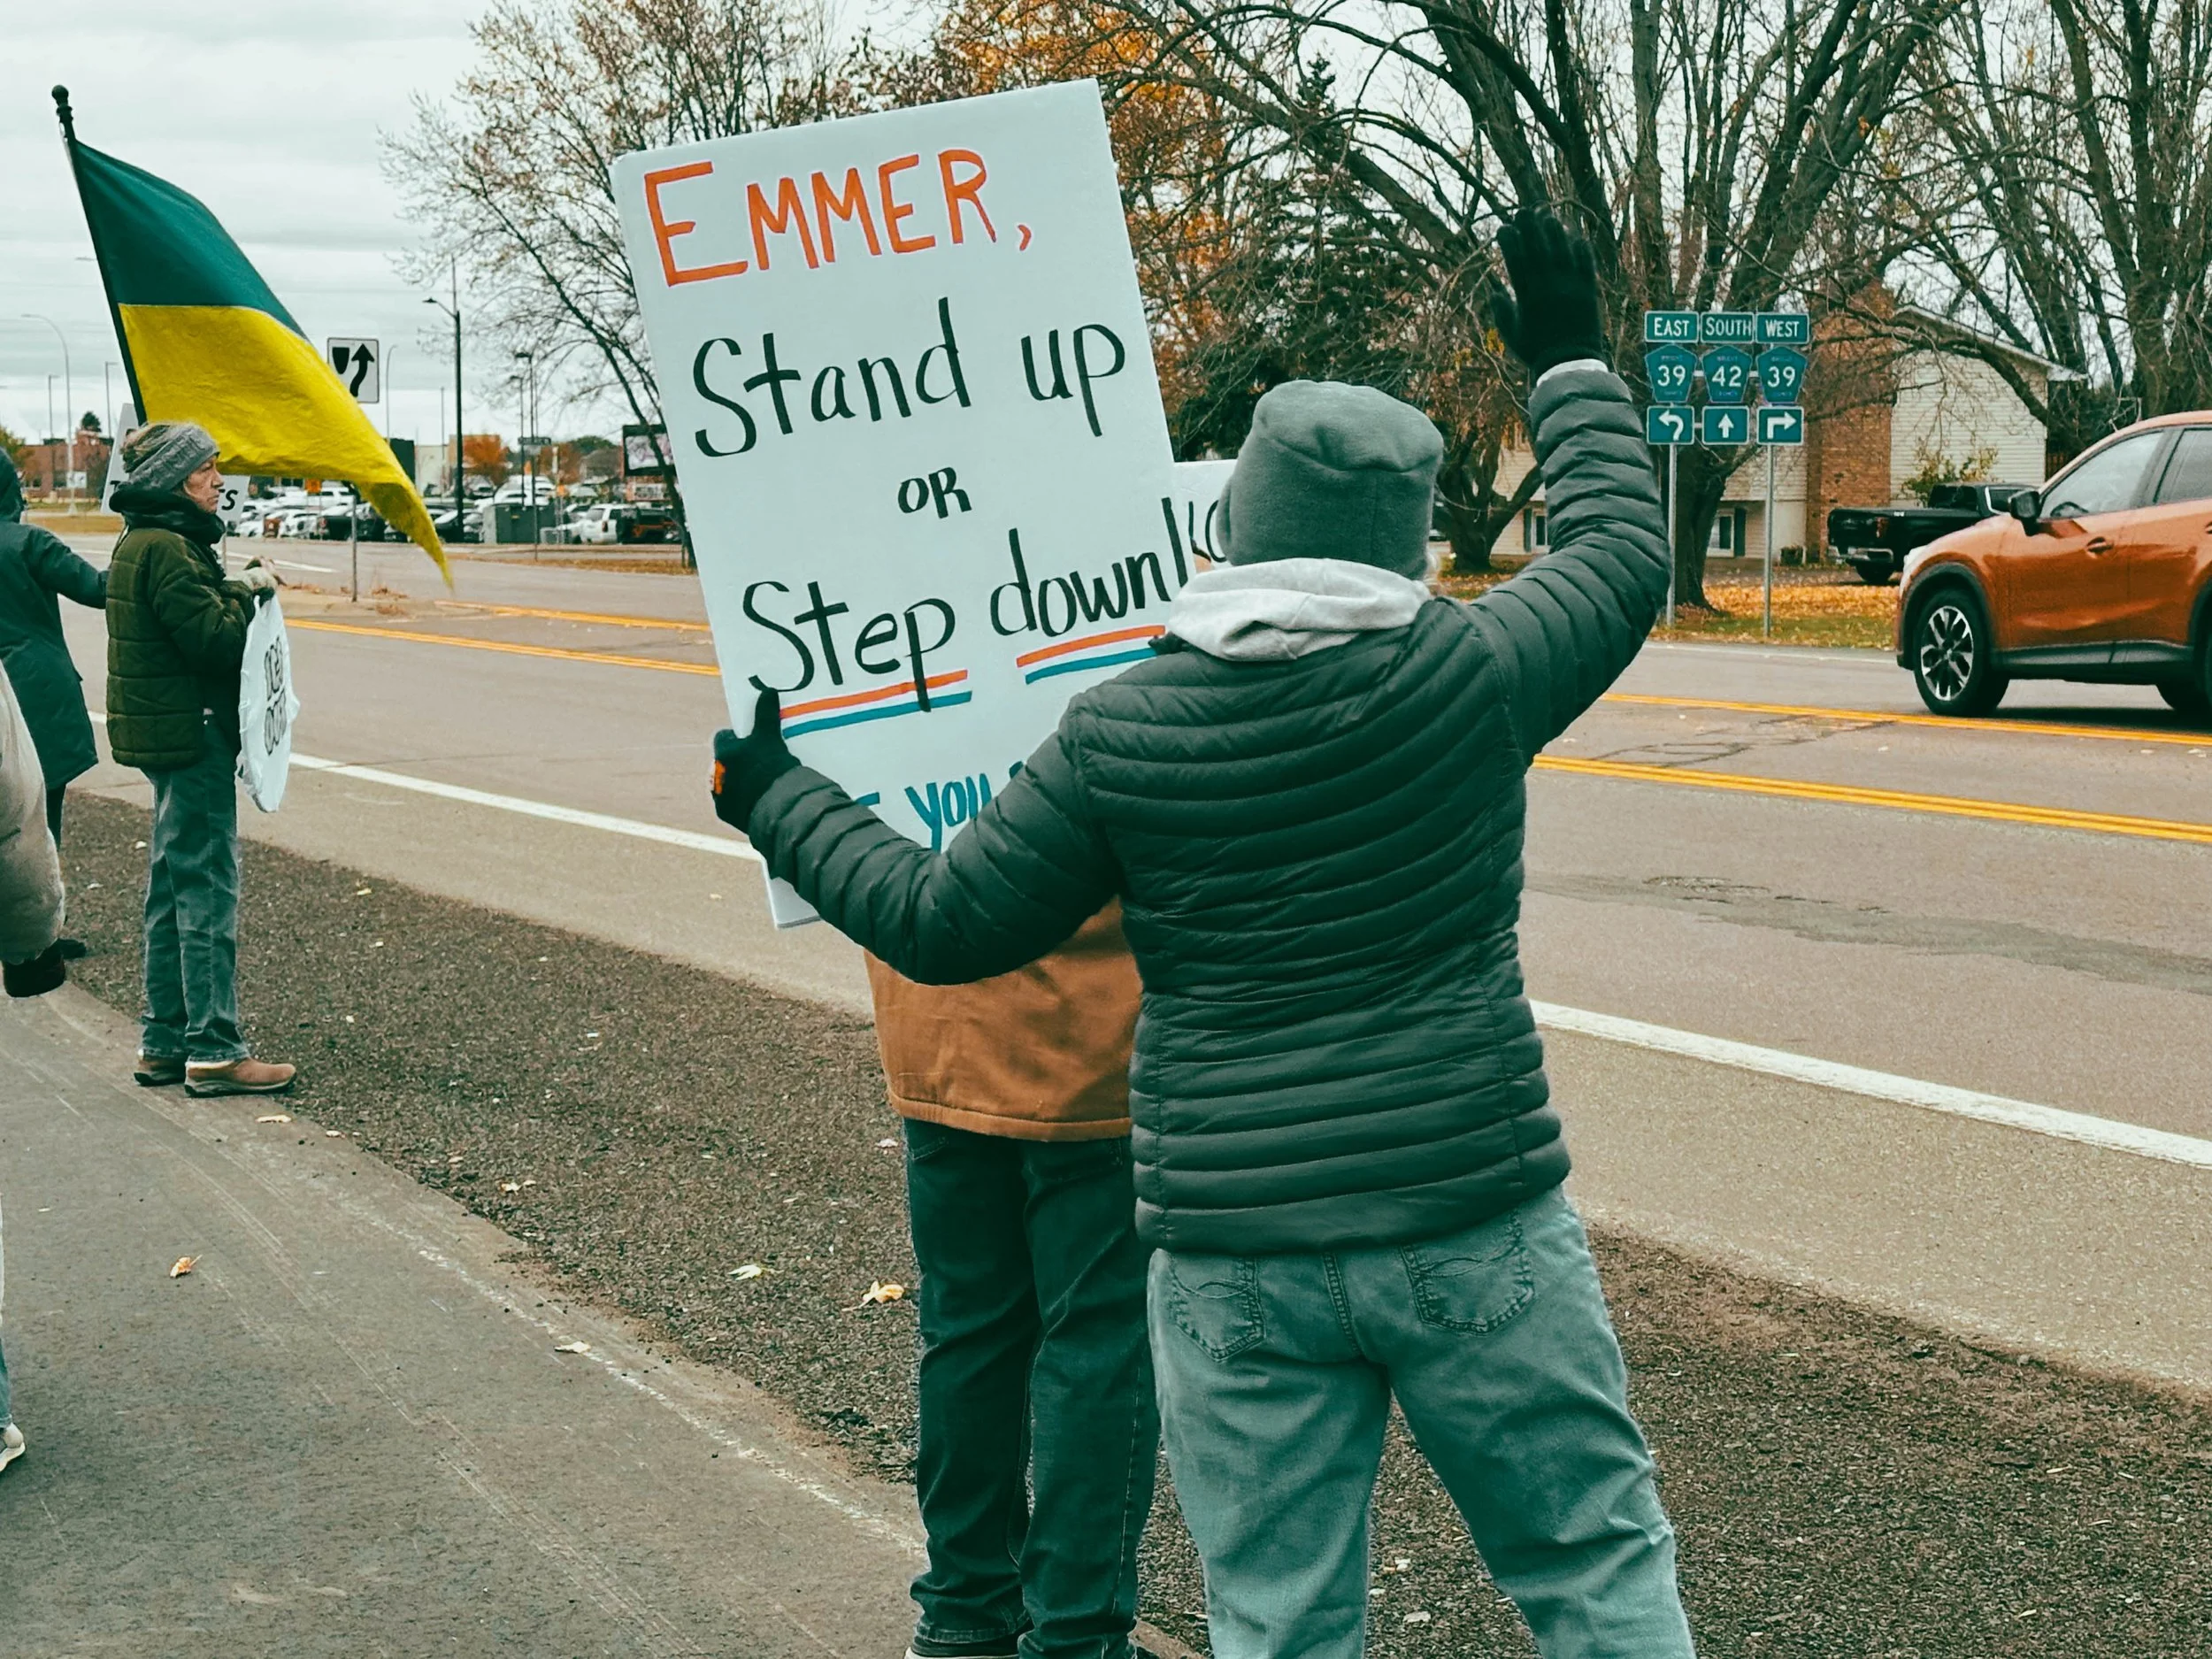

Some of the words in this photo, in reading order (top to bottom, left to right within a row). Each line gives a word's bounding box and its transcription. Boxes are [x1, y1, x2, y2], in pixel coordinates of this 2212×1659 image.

[645, 150, 1032, 286] EMMER,
[1654, 316, 1689, 337] EAST
[1705, 316, 1752, 337] SOUTH
[1765, 319, 1800, 338] WEST
[694, 296, 972, 457] Stand
[1020, 324, 1125, 437] up
[1657, 365, 1686, 387] 39
[1711, 365, 1742, 388] 42
[1767, 365, 1796, 388] 39
[742, 580, 956, 712] Step
